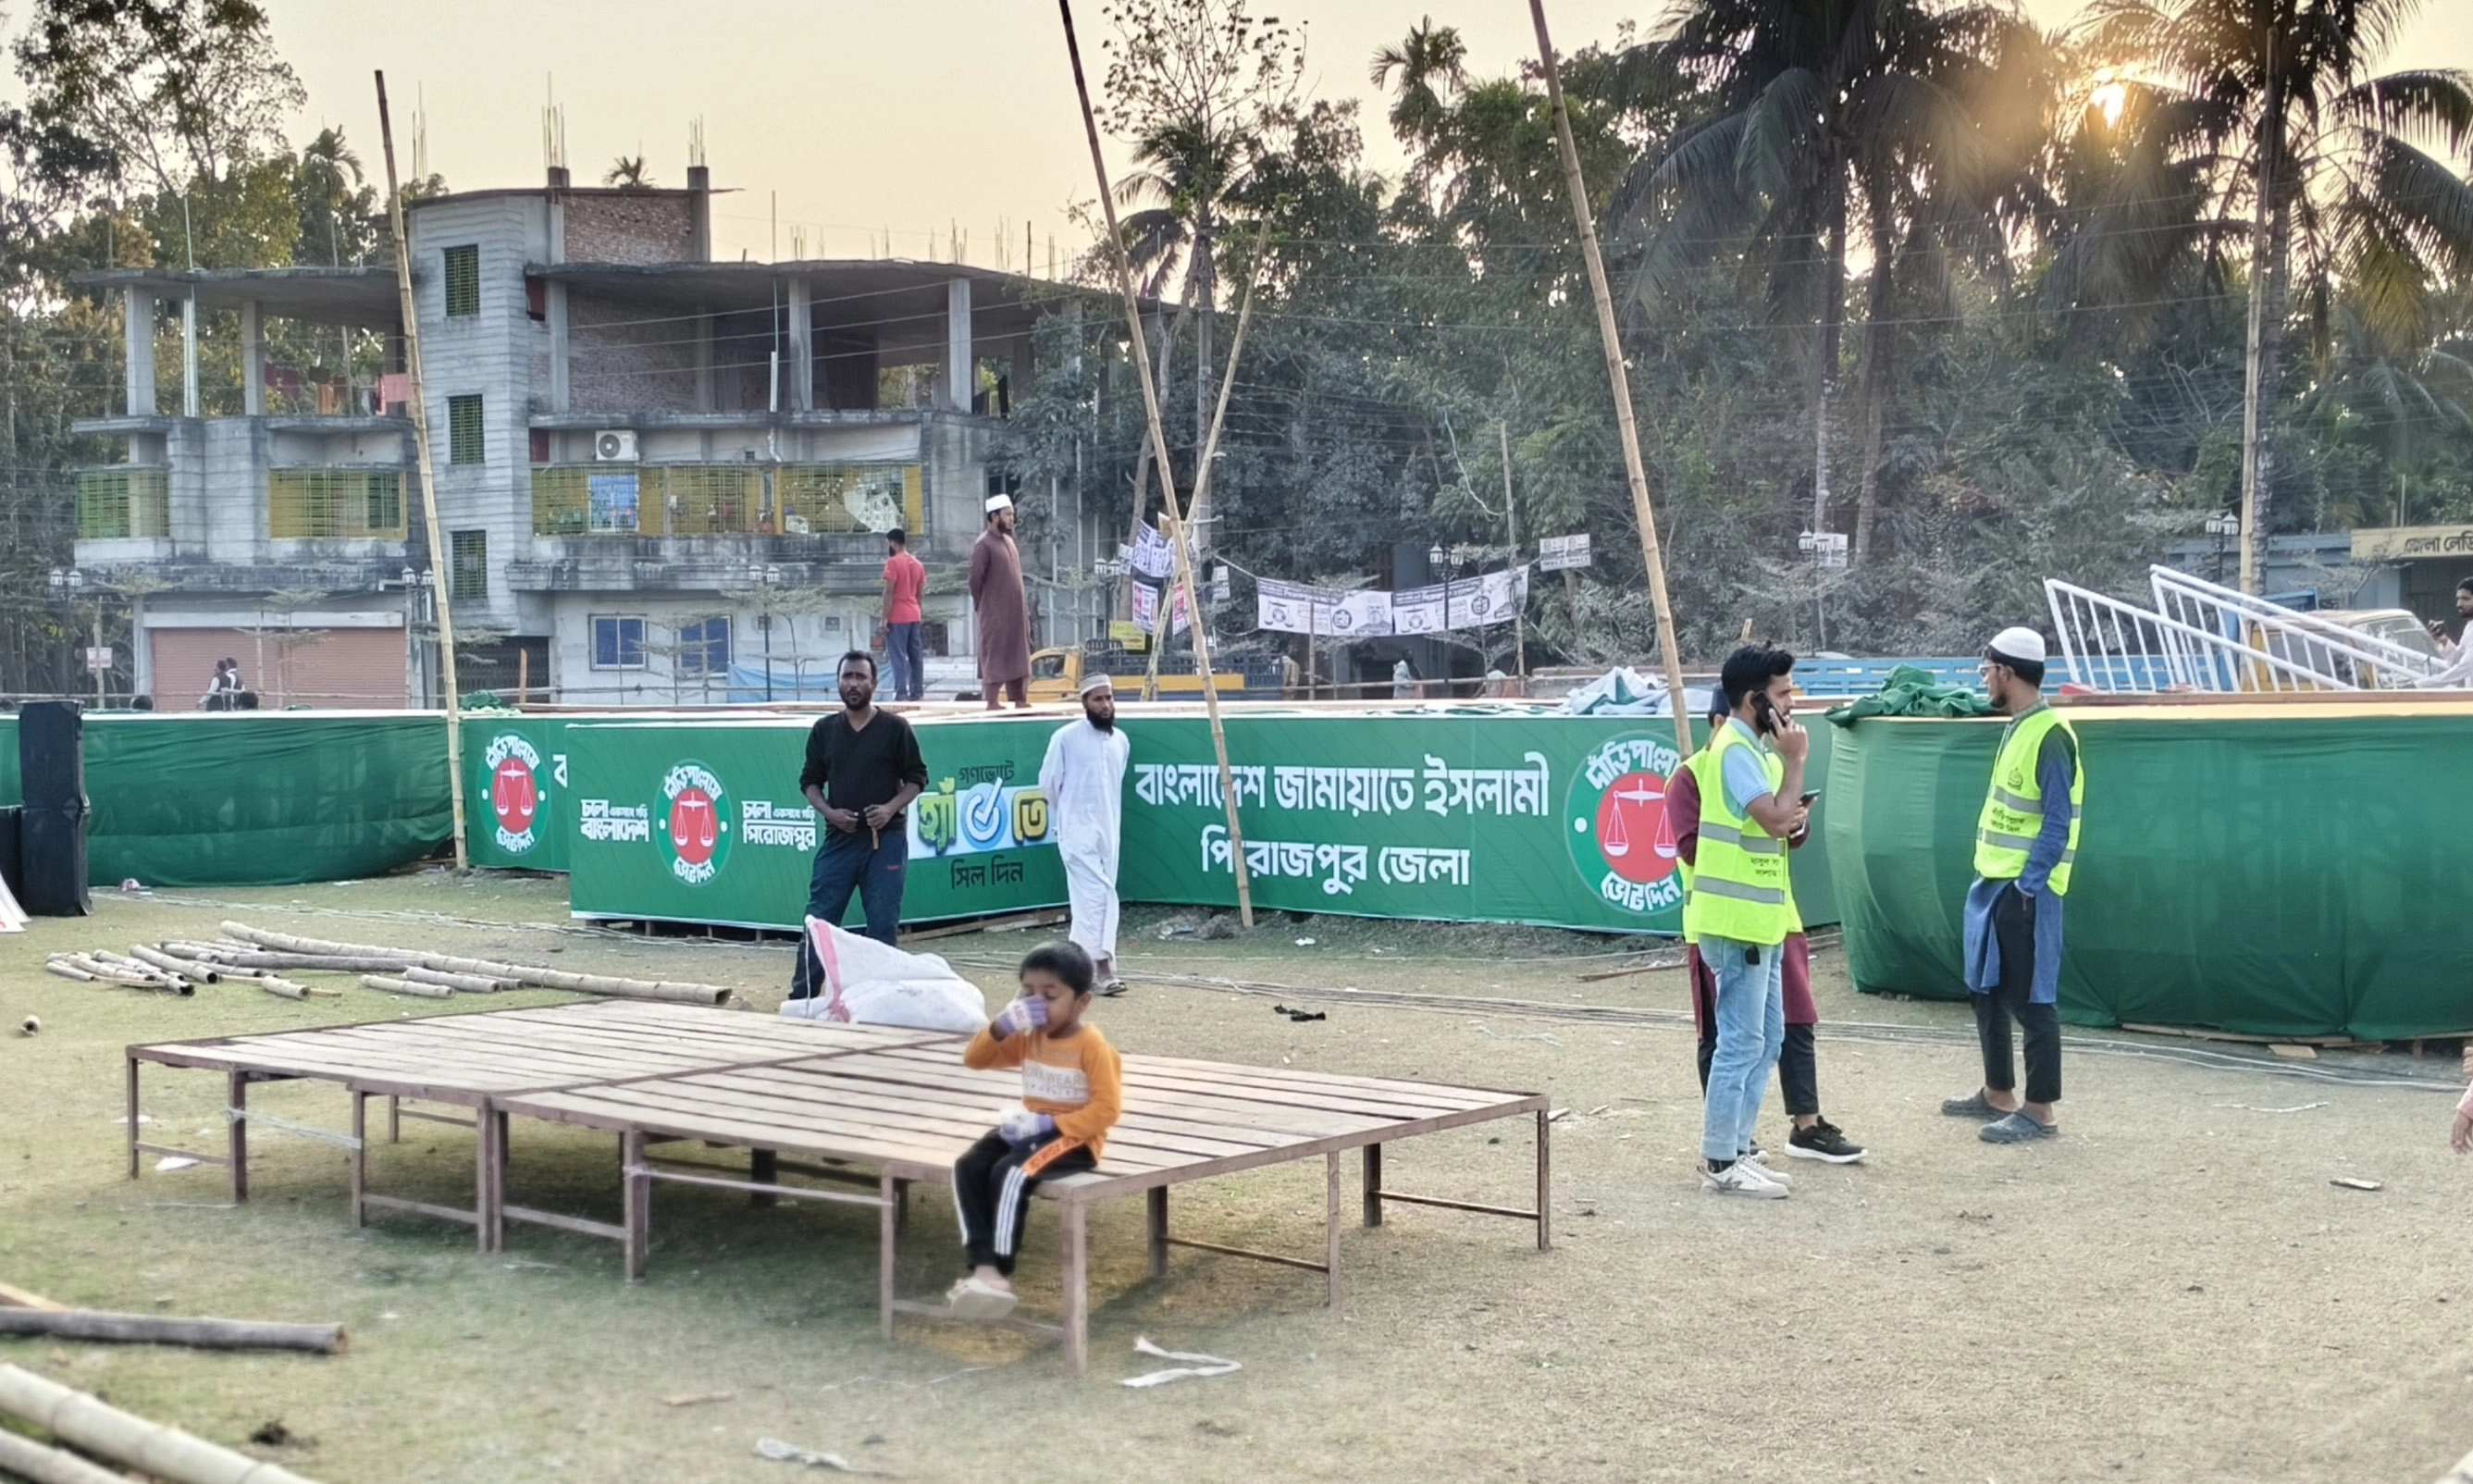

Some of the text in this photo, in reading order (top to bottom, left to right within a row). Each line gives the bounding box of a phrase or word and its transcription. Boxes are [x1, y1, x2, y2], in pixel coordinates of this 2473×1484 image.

[1134, 751, 1549, 818] বাংলাদেশ জামায়াতে ইসলামী
[580, 818, 649, 842] বাংলাদেশ
[743, 820, 816, 851] পিরোজপুর
[951, 854, 1023, 889] সিল দিন
[1379, 846, 1470, 885] জেলা
